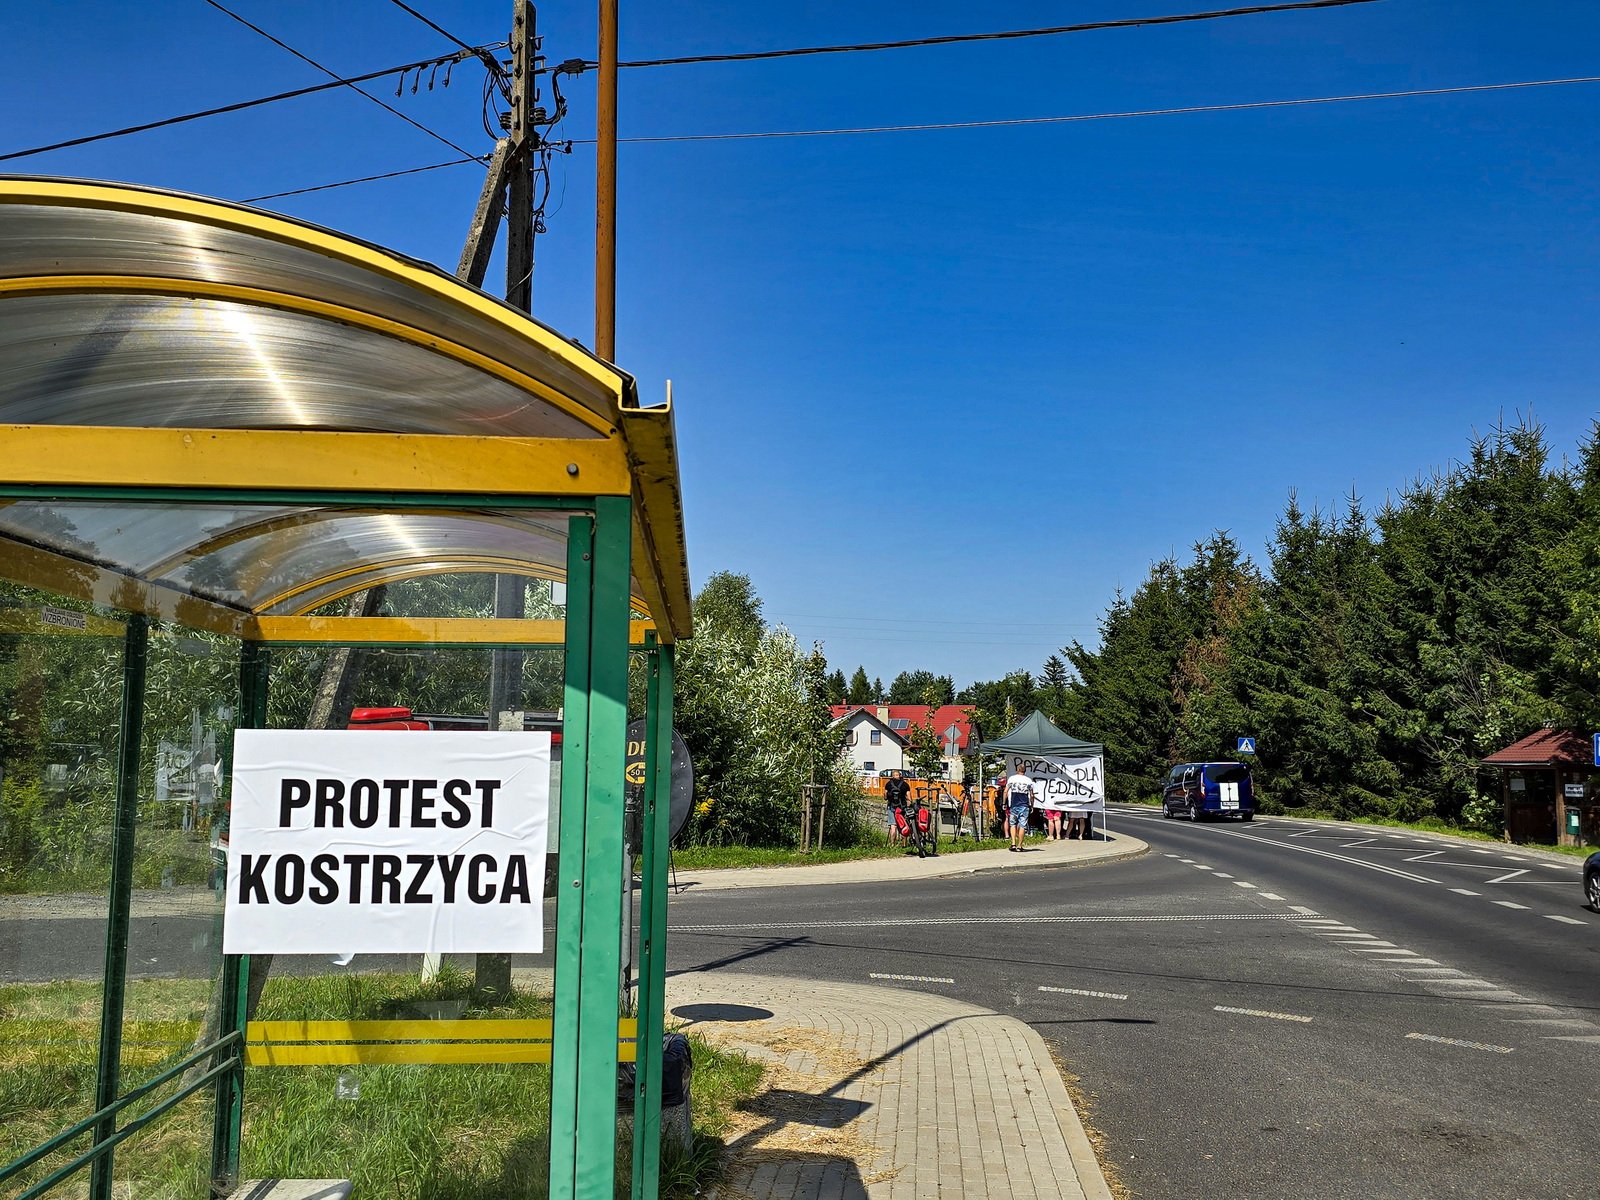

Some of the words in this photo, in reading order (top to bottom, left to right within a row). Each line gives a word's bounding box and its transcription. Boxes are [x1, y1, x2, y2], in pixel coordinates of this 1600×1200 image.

[42, 612, 86, 629] WZBRONIONE
[1074, 766, 1099, 781] DLA
[279, 778, 501, 829] PROTEST
[238, 853, 531, 905] KOSTRZYCA
